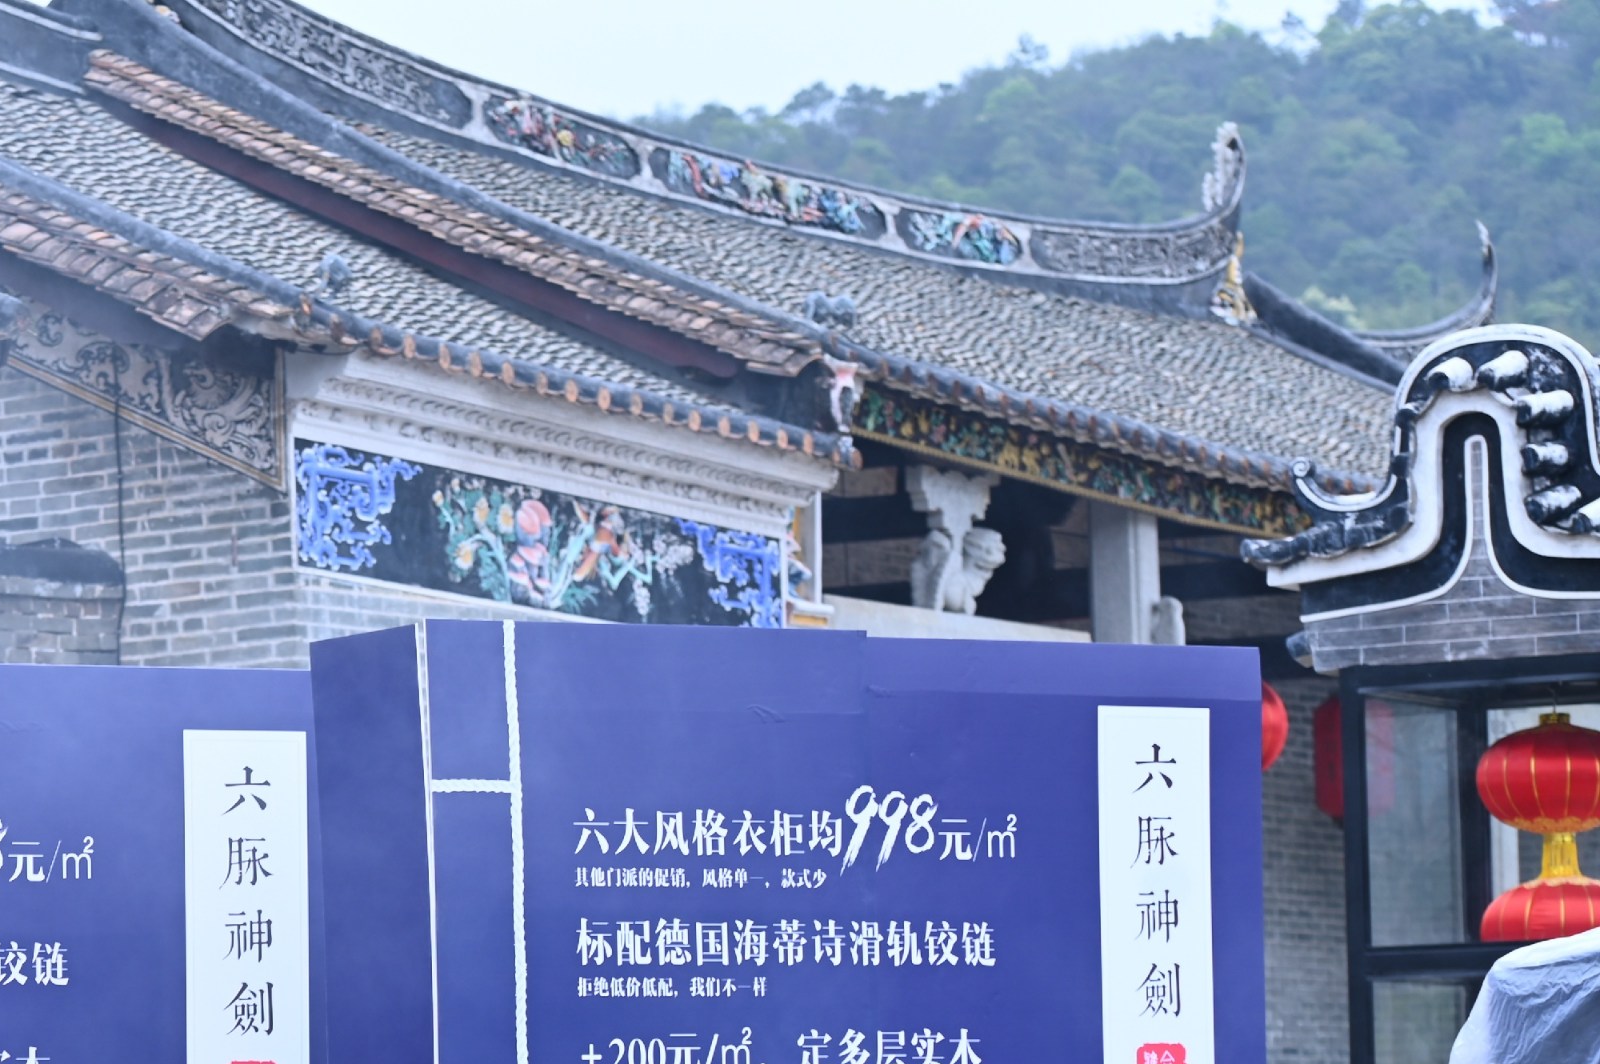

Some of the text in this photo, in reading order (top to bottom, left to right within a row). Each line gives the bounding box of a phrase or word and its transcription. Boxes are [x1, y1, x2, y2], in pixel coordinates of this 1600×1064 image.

[576, 918, 996, 966] 标配德国海蒂诗滑轨铰链
